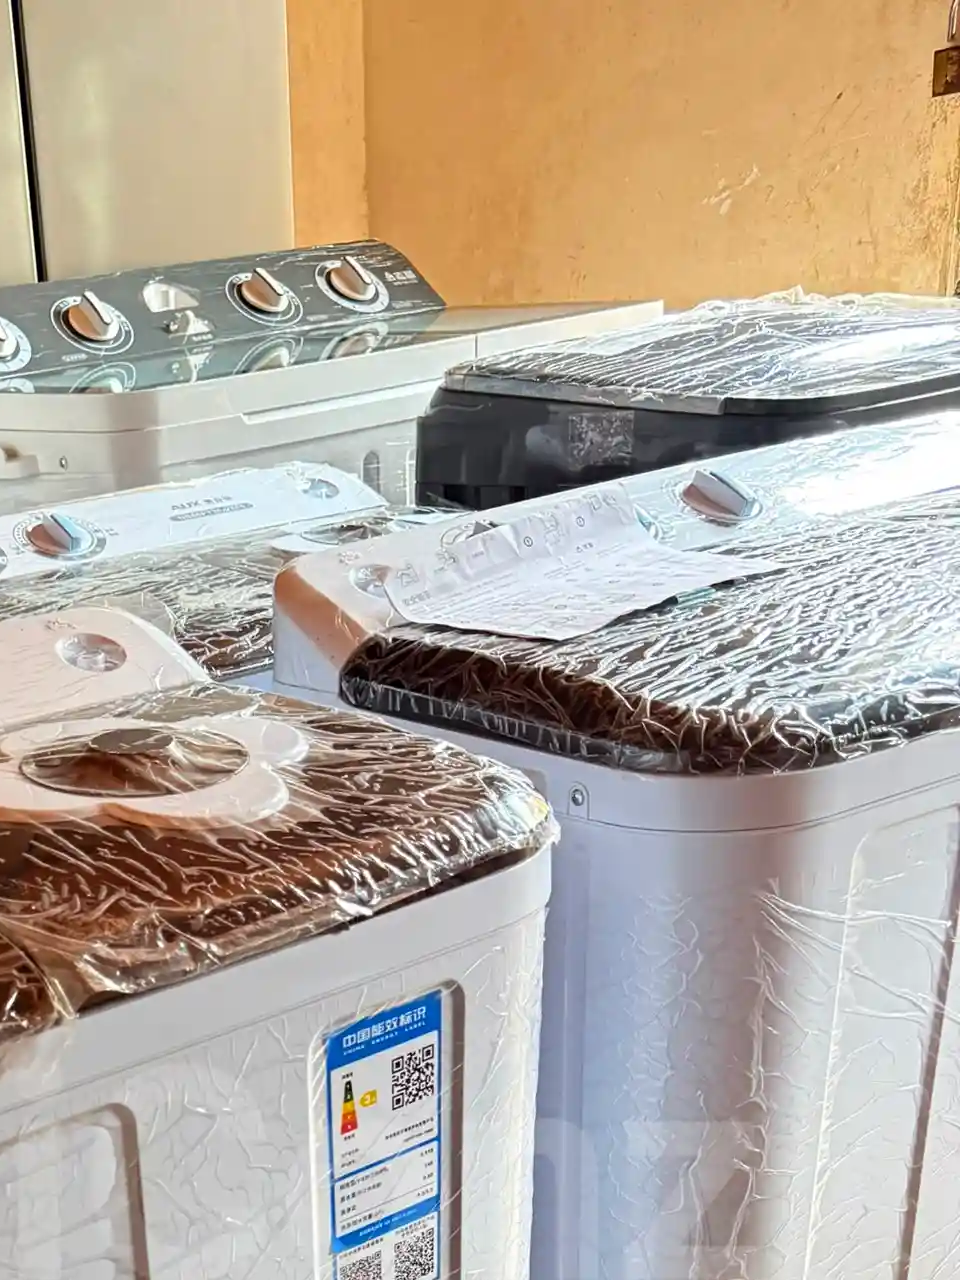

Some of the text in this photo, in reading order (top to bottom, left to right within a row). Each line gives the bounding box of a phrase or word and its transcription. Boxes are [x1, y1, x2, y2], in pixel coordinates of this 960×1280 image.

[342, 1005, 427, 1049] 中国能效标识
